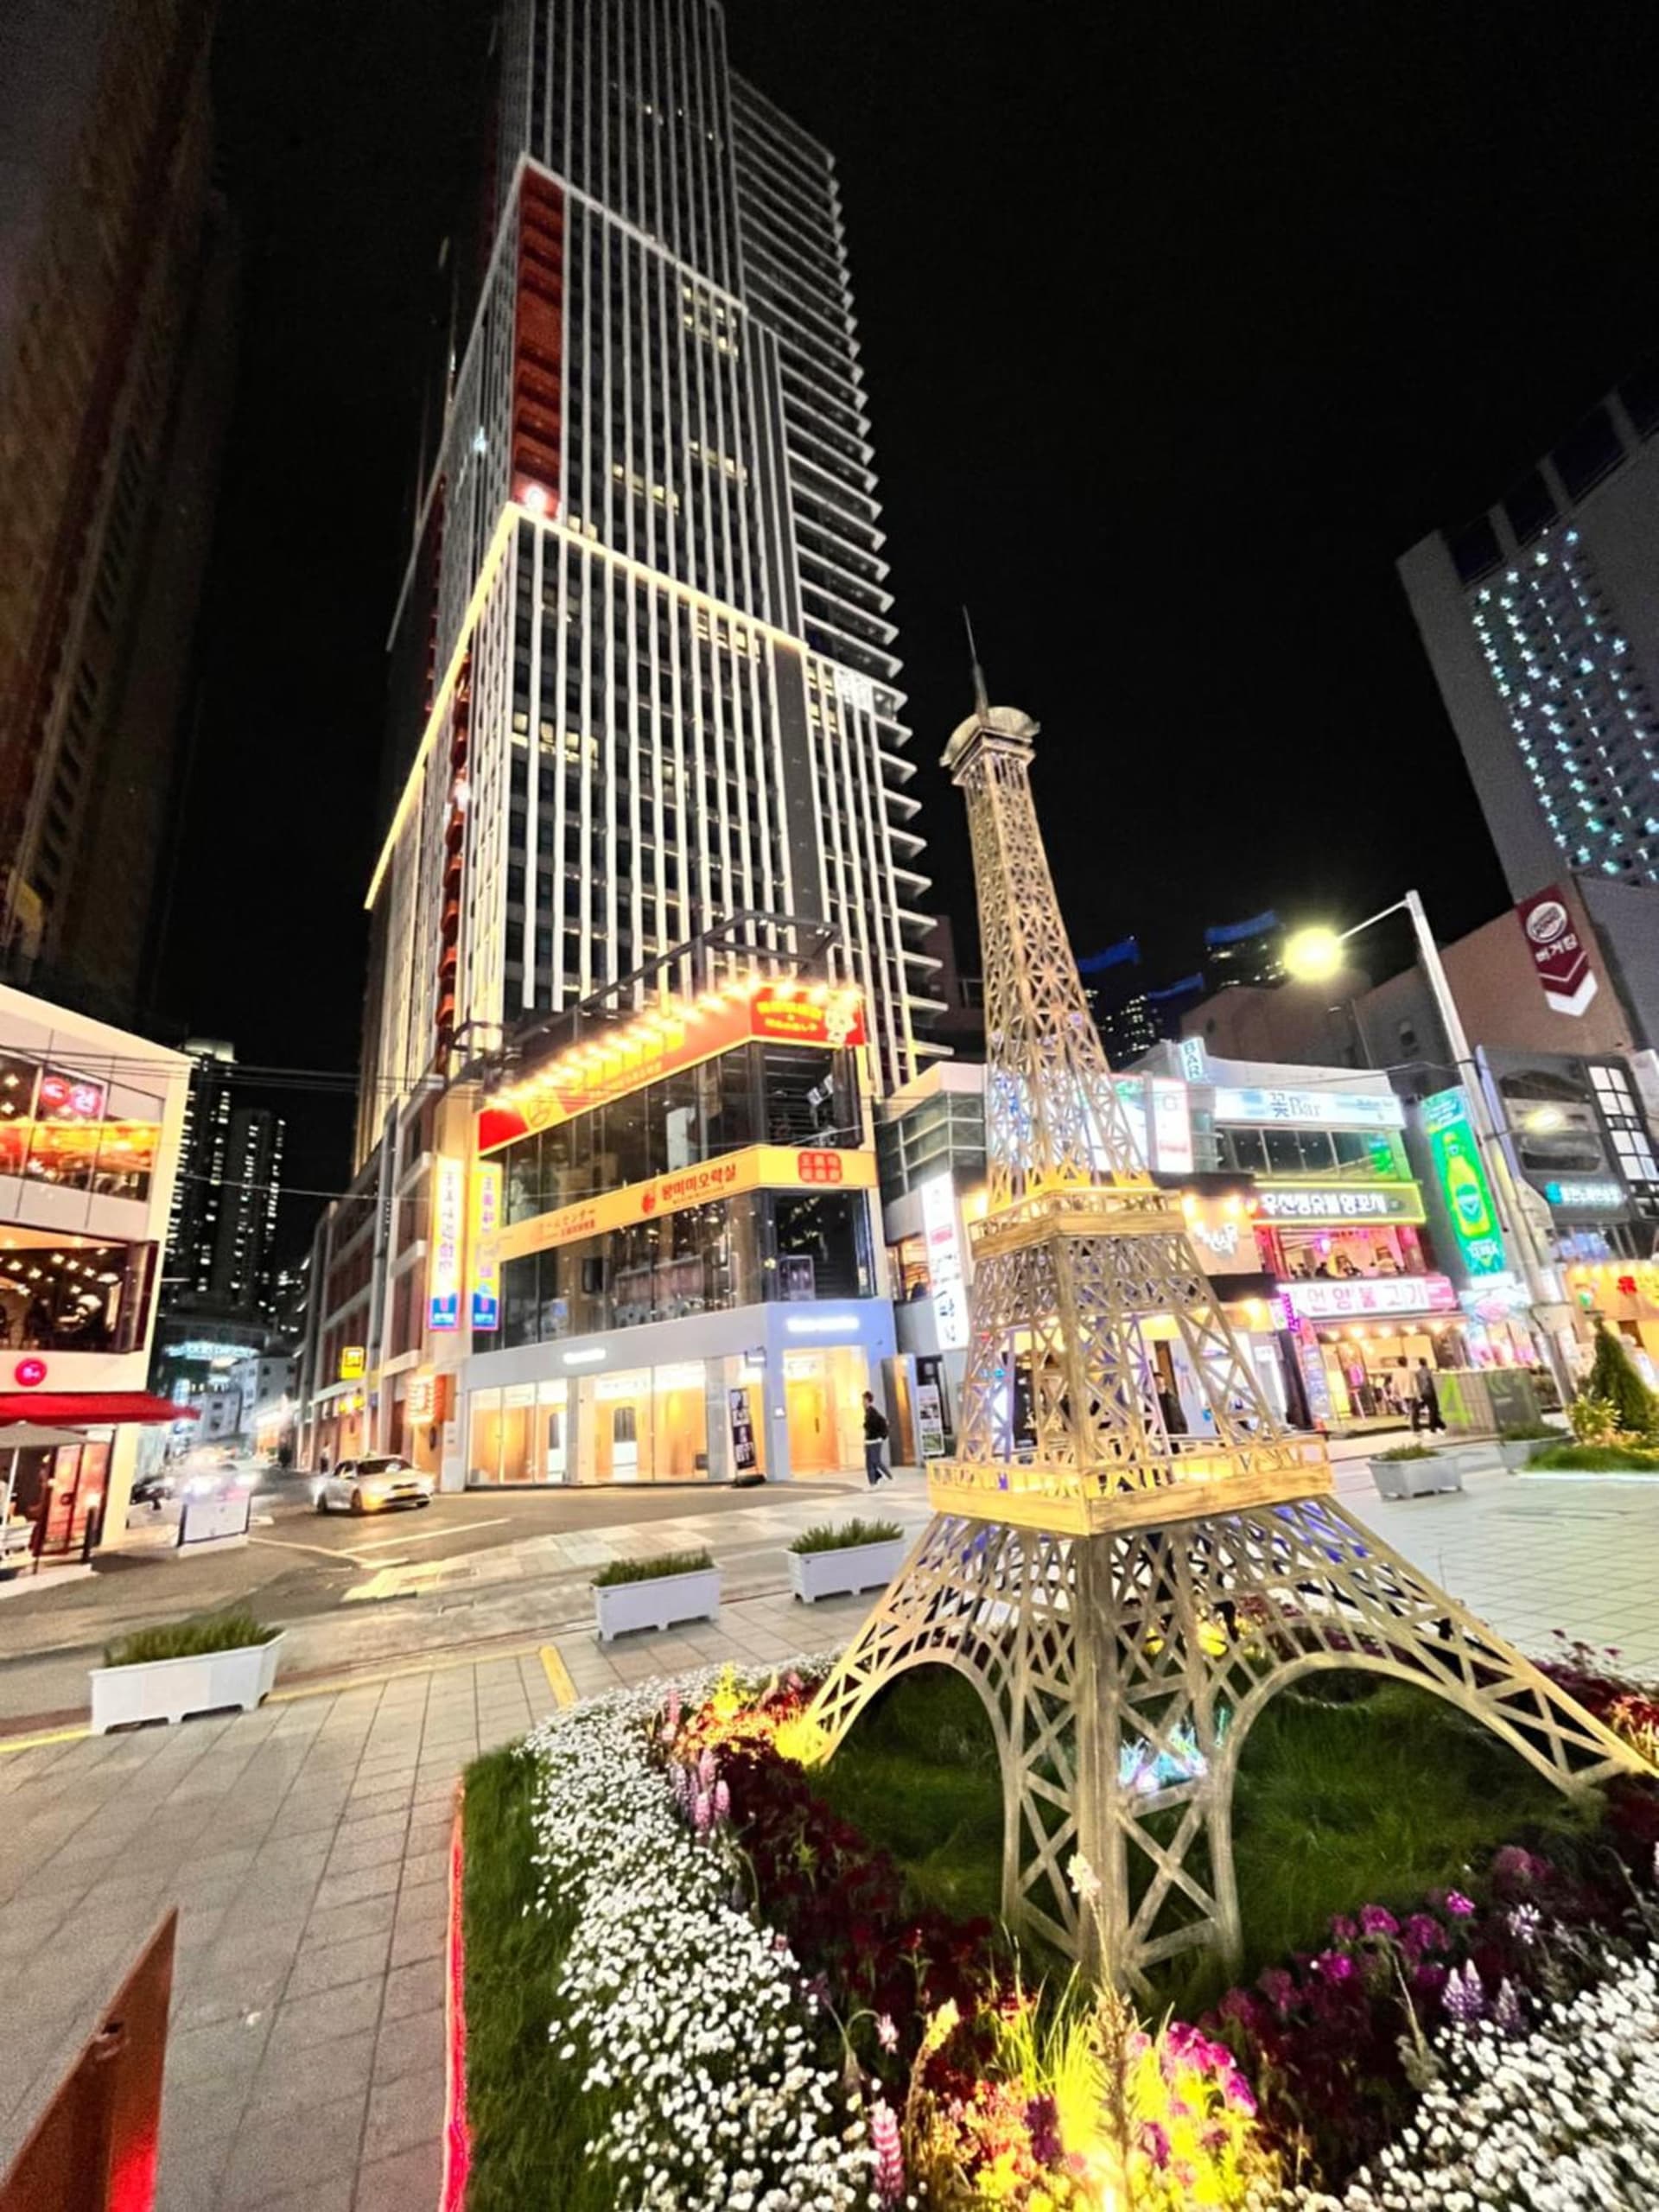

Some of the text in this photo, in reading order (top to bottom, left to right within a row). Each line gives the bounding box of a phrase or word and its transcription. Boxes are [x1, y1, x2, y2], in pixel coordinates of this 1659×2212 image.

[1535, 933, 1579, 963] 버거킹
[1183, 1040, 1202, 1079] BAR
[1306, 1283, 1425, 1312] 언양불고기
